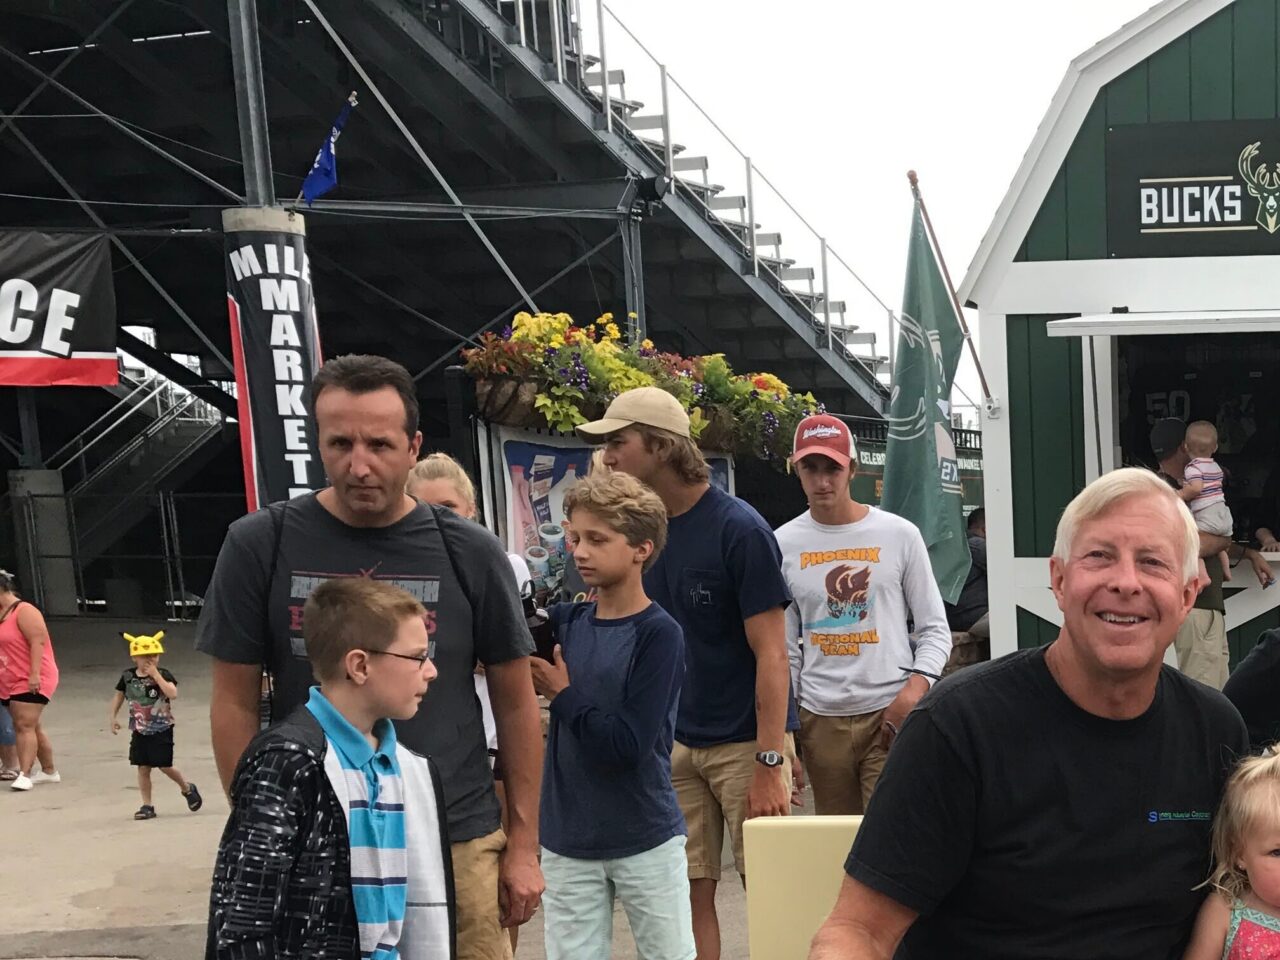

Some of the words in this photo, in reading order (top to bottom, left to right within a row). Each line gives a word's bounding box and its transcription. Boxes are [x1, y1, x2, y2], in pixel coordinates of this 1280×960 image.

[1140, 184, 1242, 224] BUCKS
[258, 278, 315, 501] MARKET
[800, 547, 881, 570] PHOENIX
